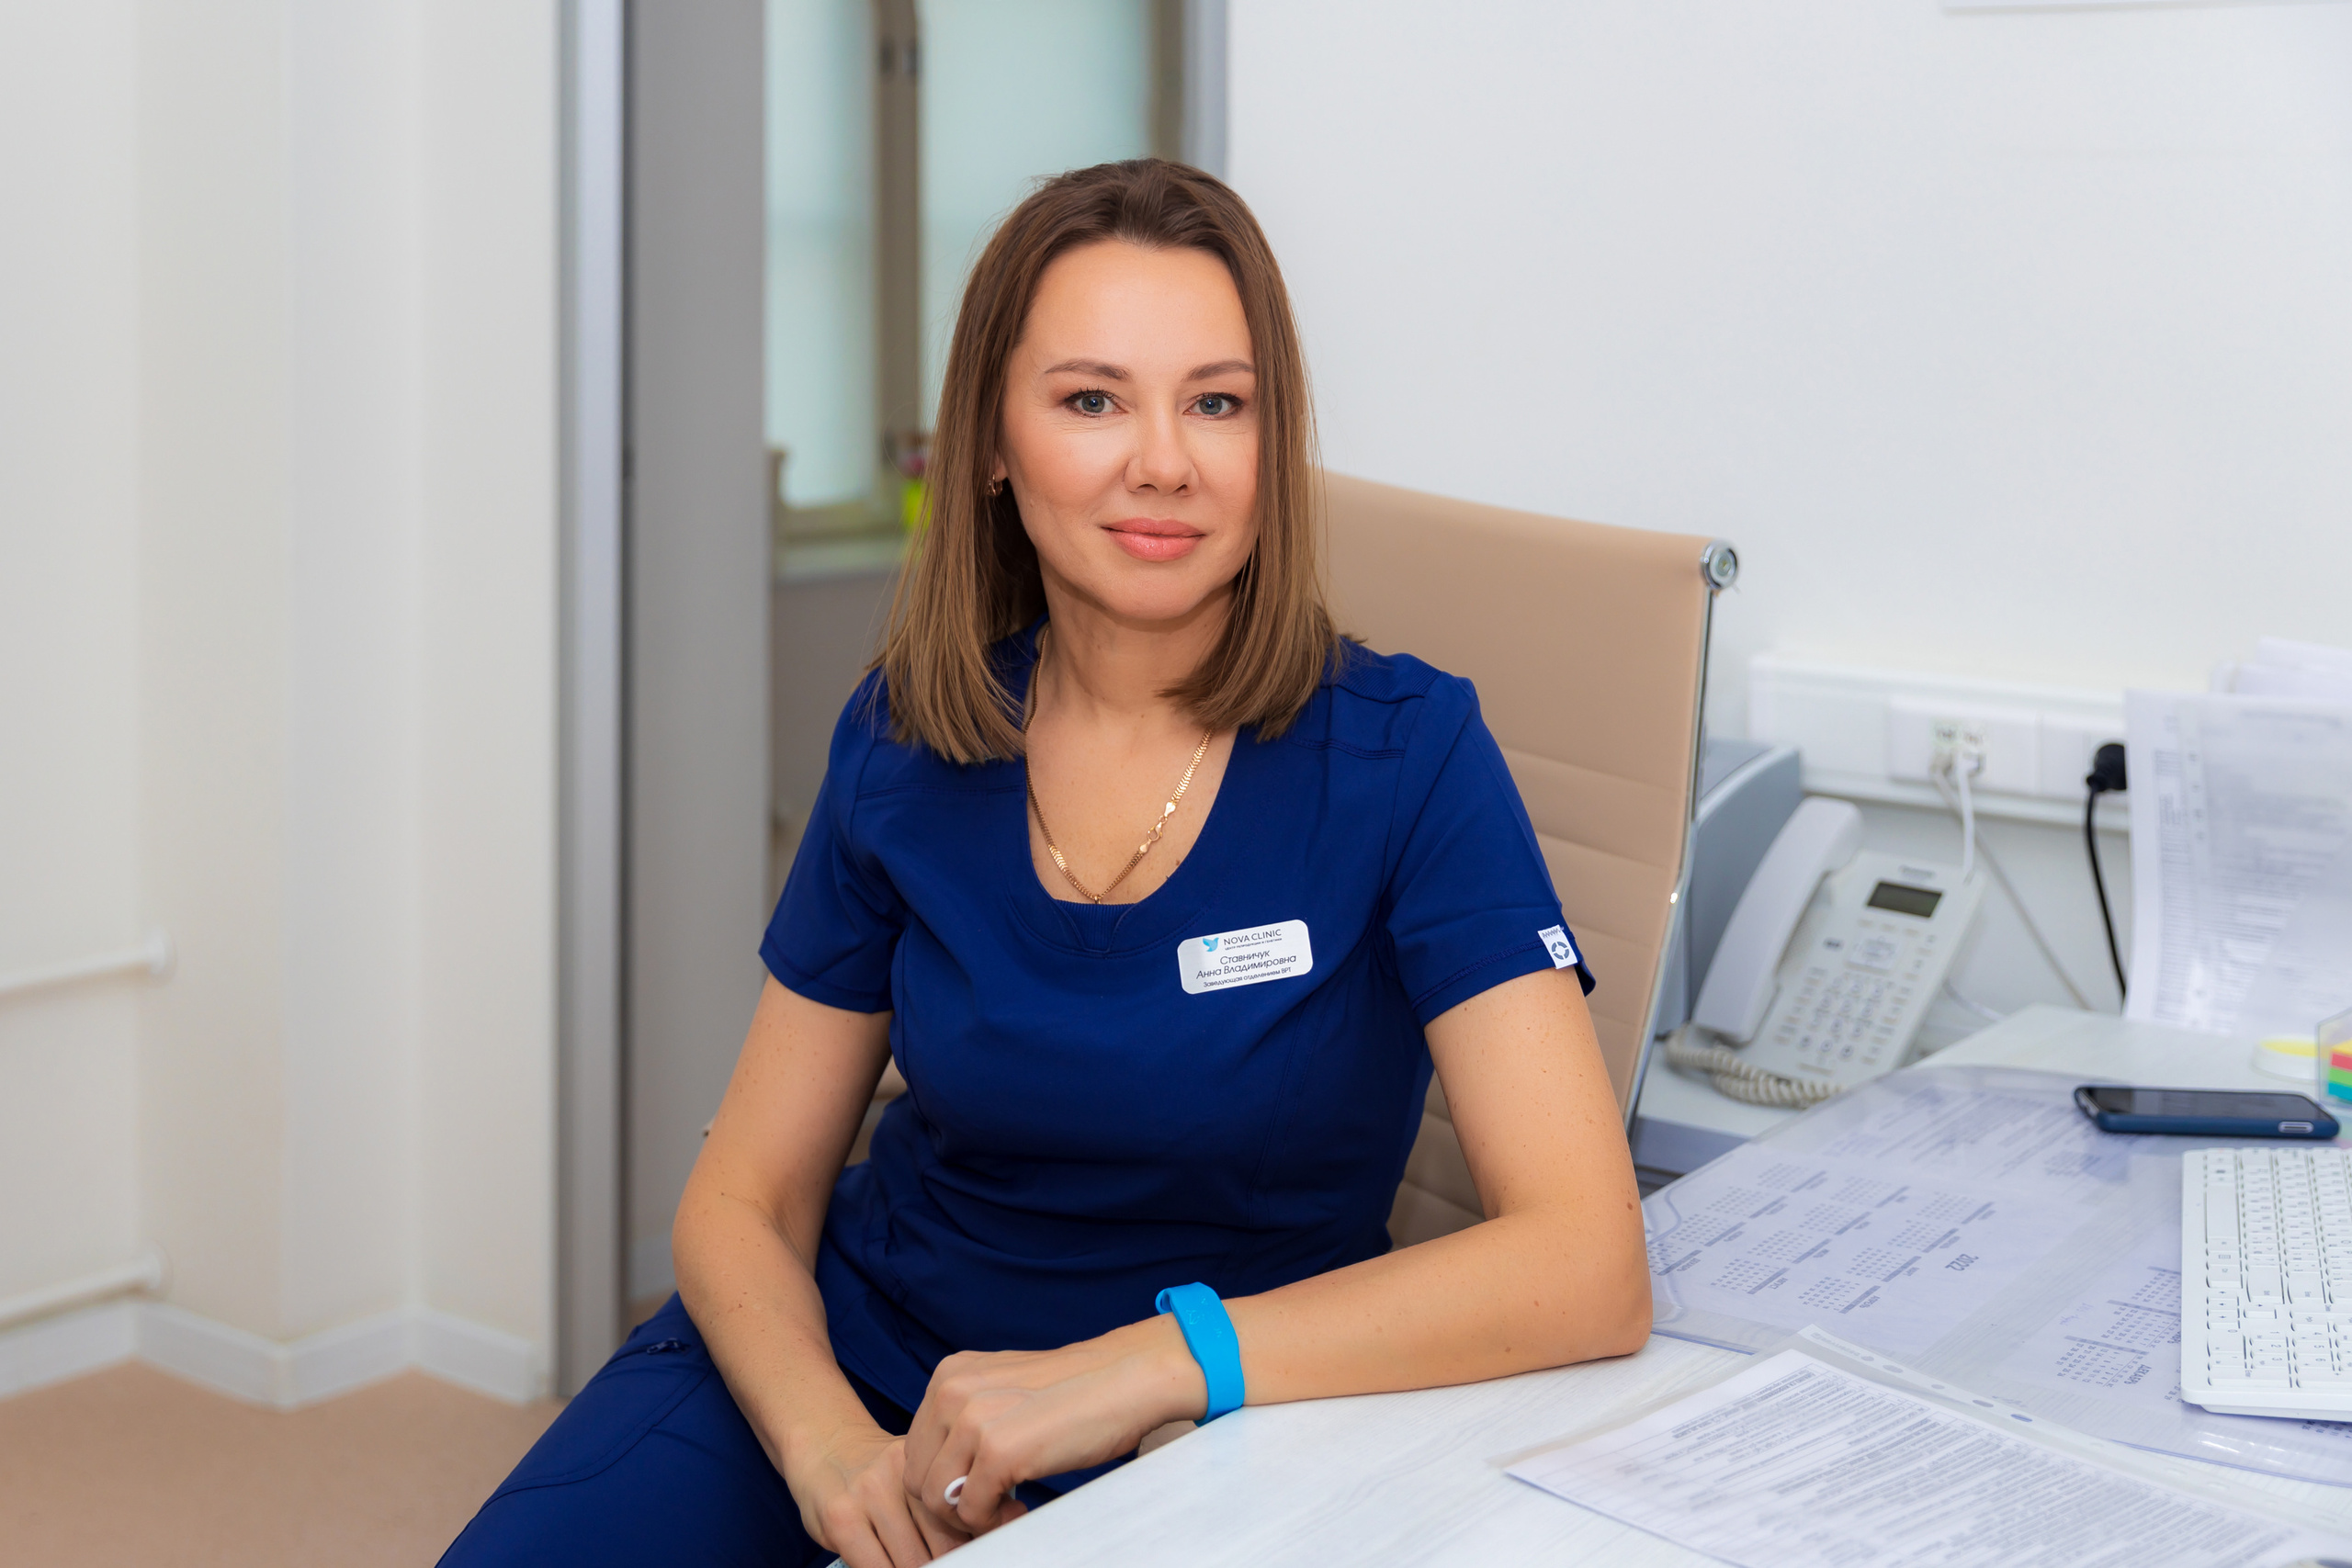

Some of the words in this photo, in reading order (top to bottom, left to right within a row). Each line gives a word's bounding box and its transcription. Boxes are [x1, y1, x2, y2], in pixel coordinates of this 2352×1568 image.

[1224, 935, 1250, 945] NOVA
[1251, 929, 1282, 941] CLINIC
[1220, 951, 1271, 965] Ставничук
[1196, 968, 1222, 979] Анна
[1224, 955, 1296, 975] Владимировна
[1203, 976, 1242, 987] Заведующая
[1243, 970, 1280, 981] отделением
[1944, 1253, 1979, 1271] 2022
[2123, 1364, 2153, 1384] ДЕКАБРЬ
